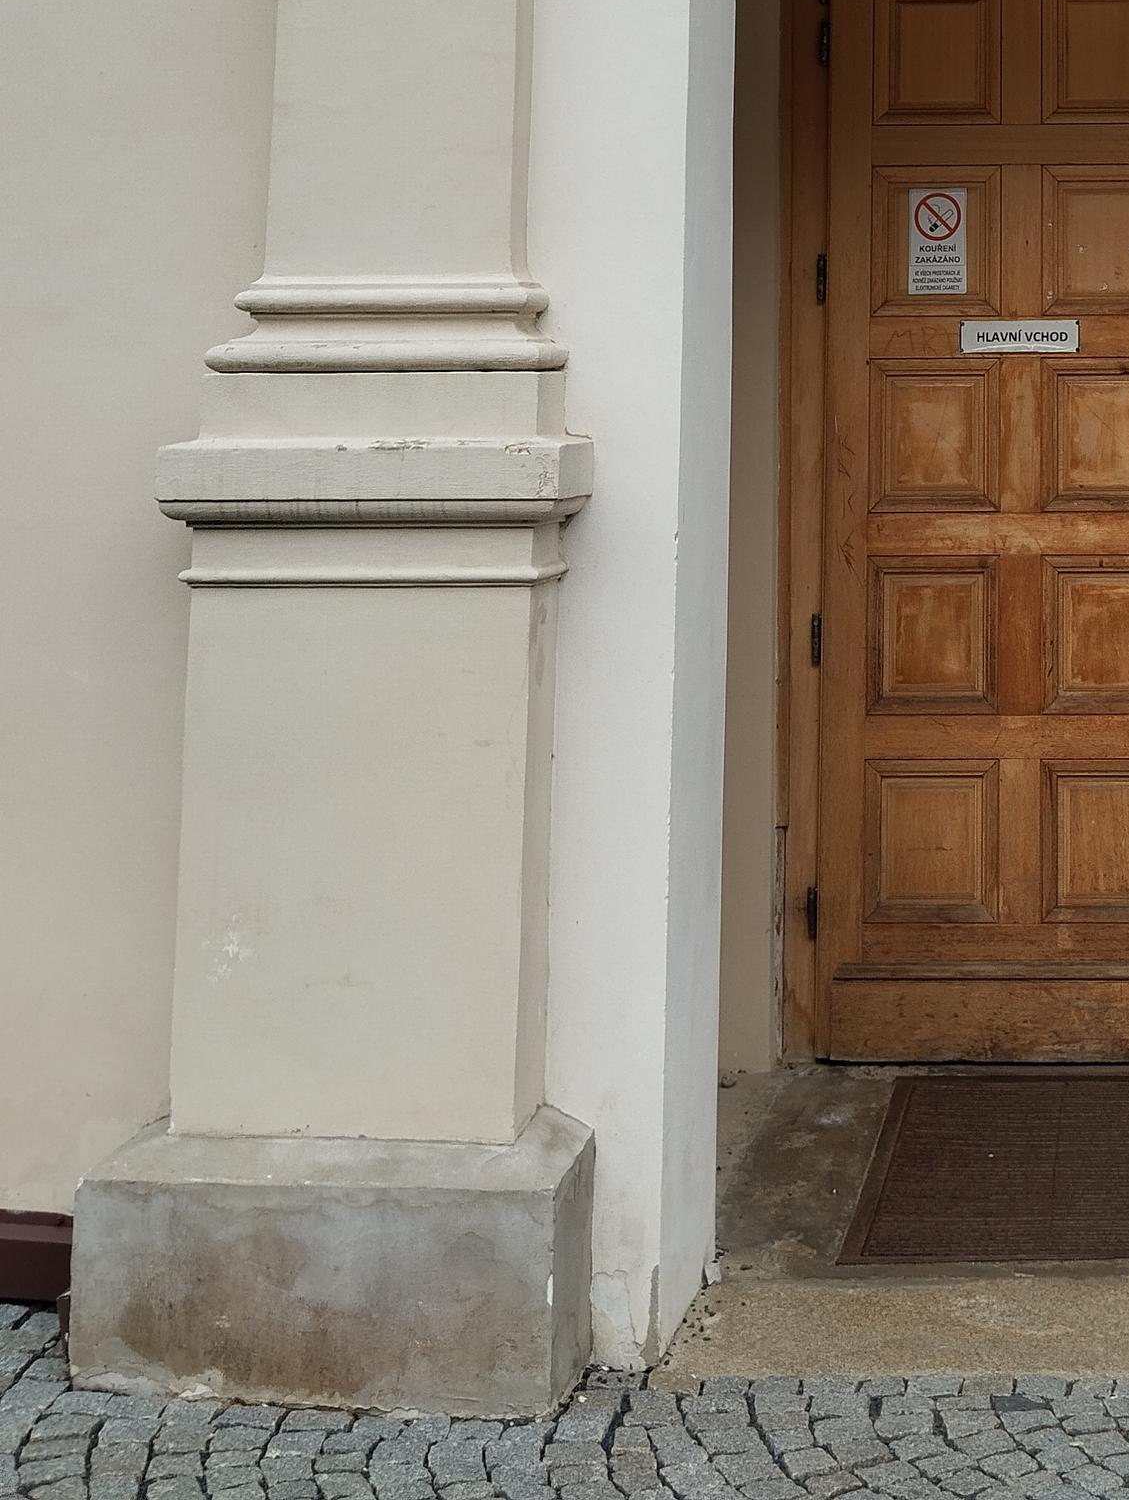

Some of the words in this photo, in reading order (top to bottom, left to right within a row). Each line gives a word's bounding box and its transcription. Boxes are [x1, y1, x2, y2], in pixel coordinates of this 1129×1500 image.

[919, 244, 956, 253] KOUŘENÍ
[915, 255, 960, 264] ZAKÁZÁNO
[977, 329, 1022, 343] HLAVNÍ
[1024, 331, 1068, 342] VCHOD
